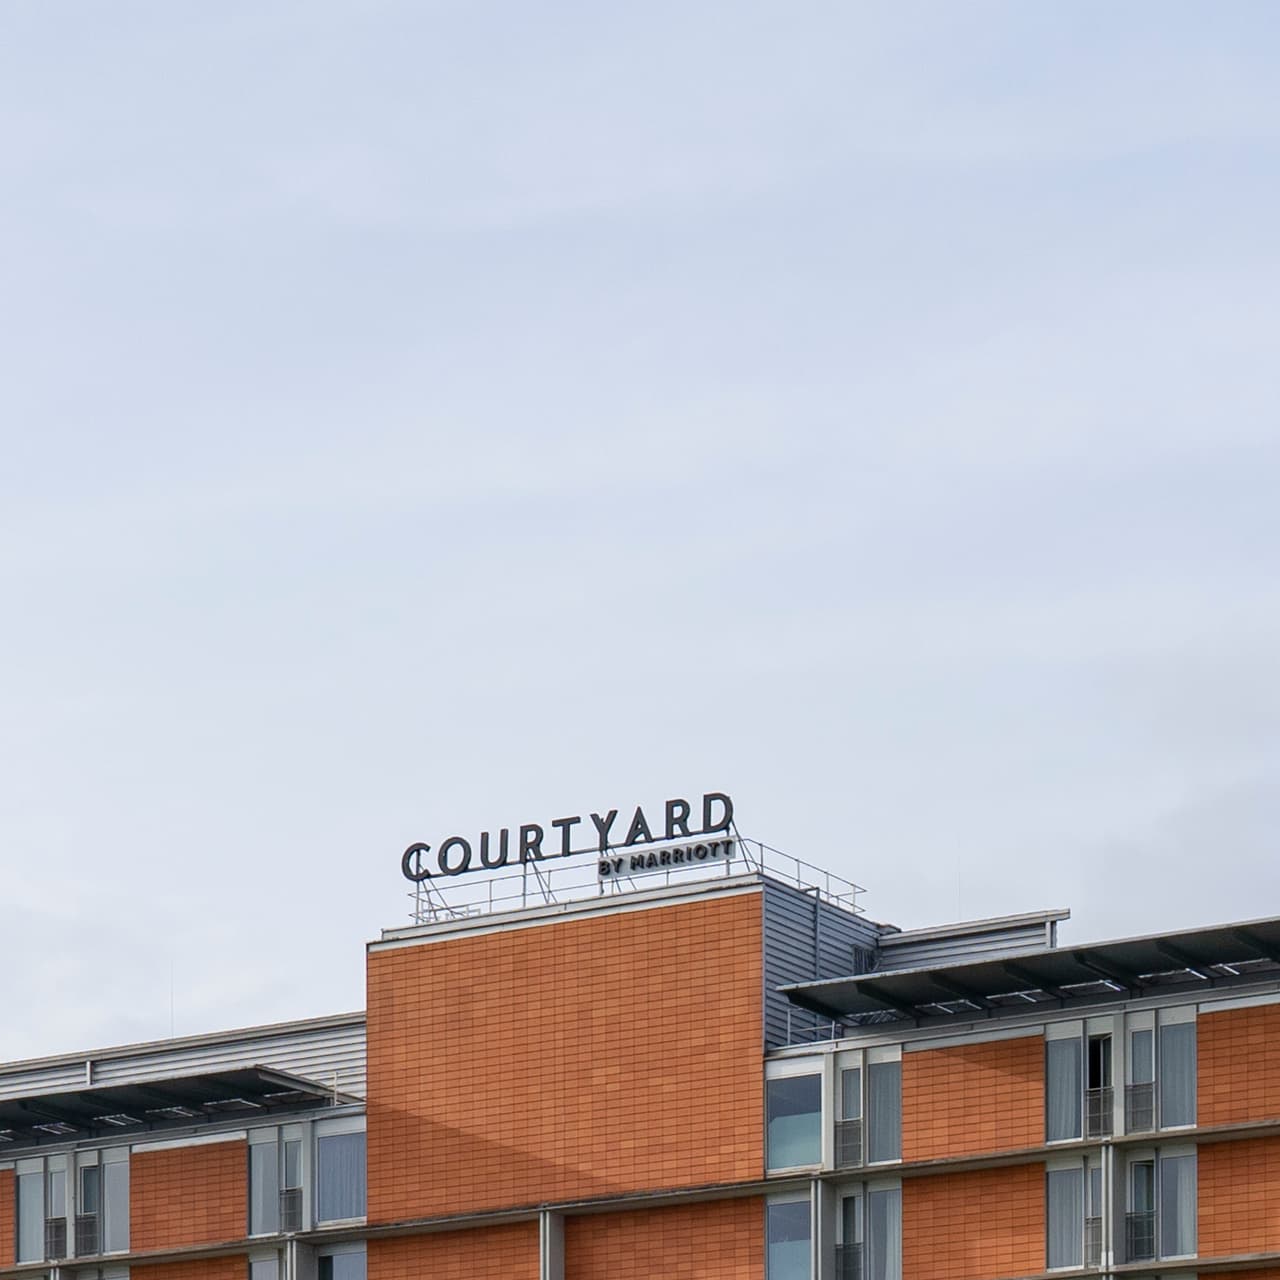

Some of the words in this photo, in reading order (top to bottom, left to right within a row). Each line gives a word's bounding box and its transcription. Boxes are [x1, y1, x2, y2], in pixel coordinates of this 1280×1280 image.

[401, 792, 734, 882] COURTYARD
[598, 858, 623, 876] BY
[629, 840, 734, 871] MARRIOTT
